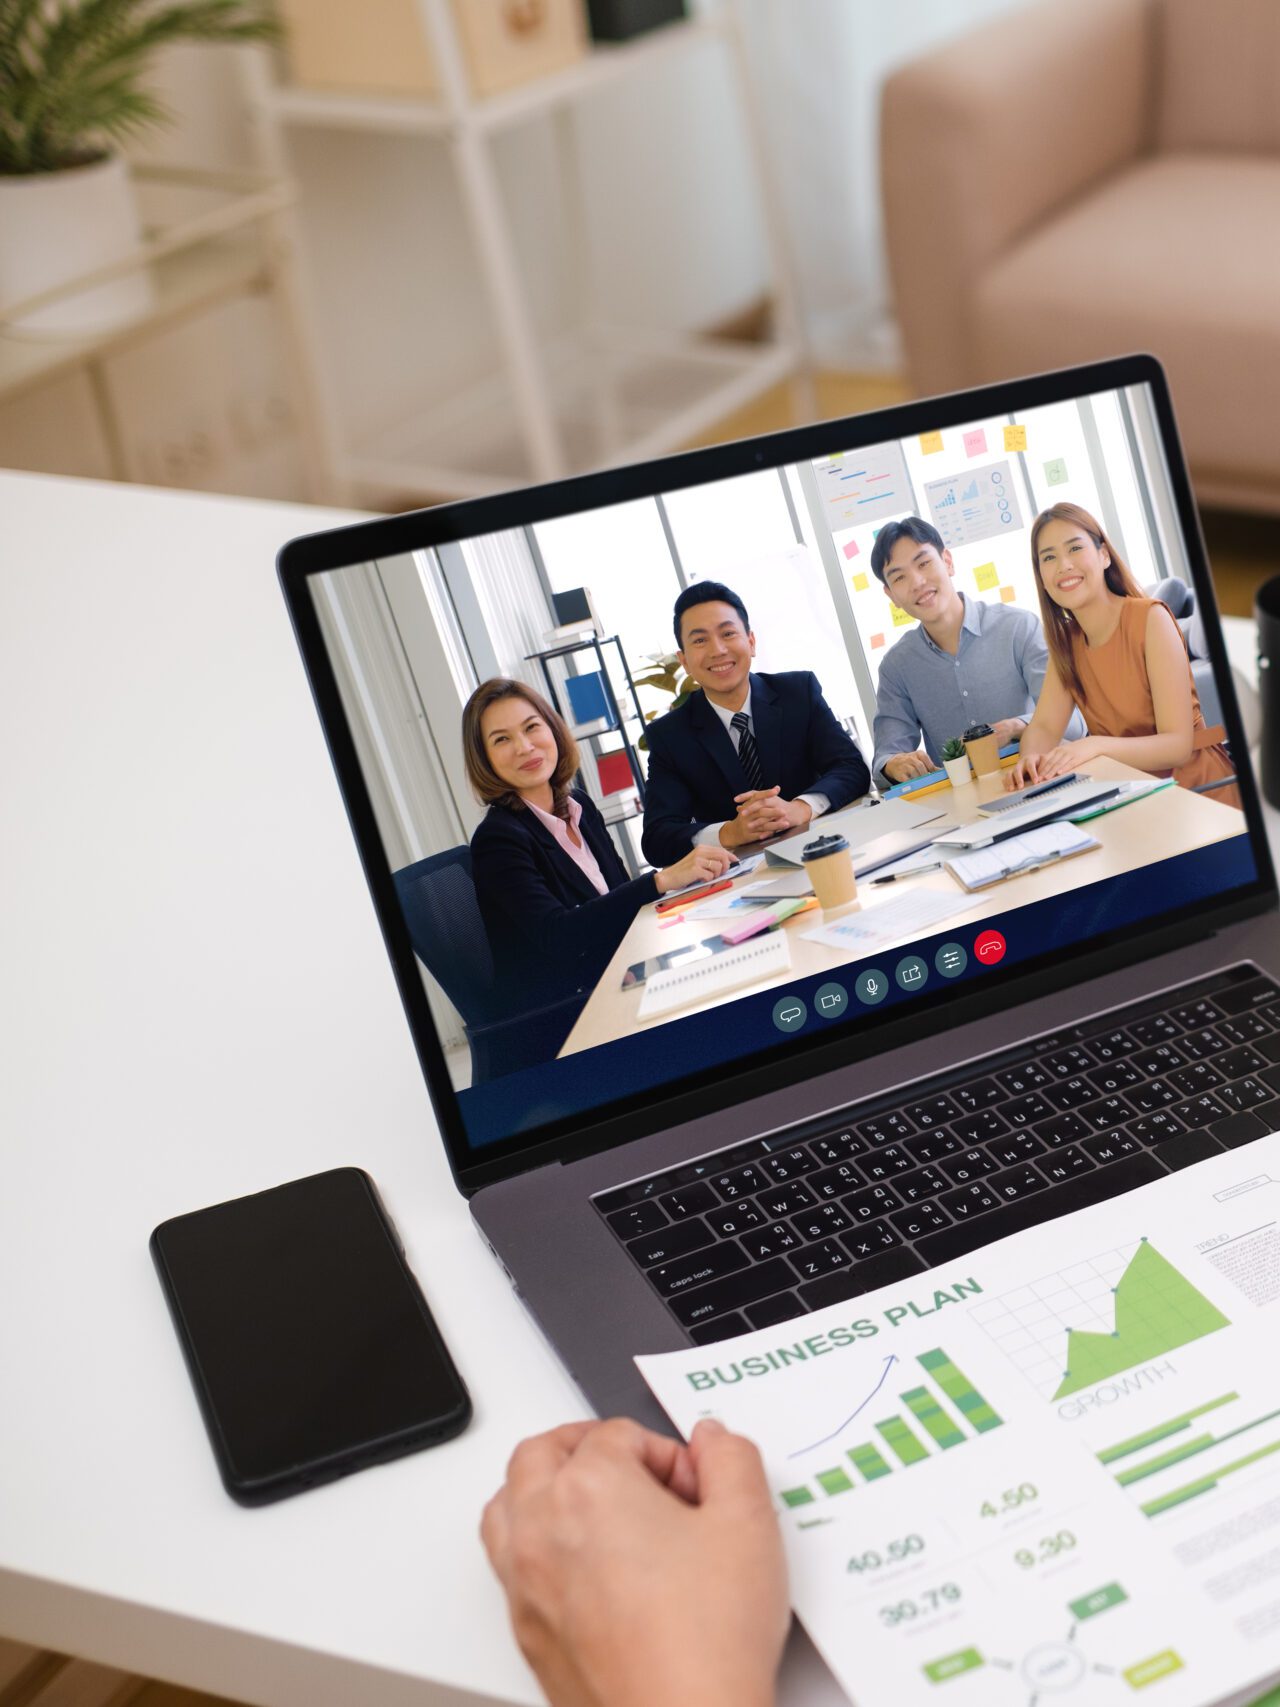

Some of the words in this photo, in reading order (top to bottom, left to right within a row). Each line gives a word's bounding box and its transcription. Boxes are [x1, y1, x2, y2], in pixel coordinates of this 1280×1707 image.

[1057, 1065, 1068, 1073] 9
[1105, 1080, 1117, 1088] O
[968, 1098, 976, 1106] 7
[1014, 1114, 1026, 1122] U
[1096, 1117, 1108, 1125] K
[874, 1133, 885, 1141] 5
[969, 1131, 978, 1139] Y
[1054, 1134, 1061, 1142] J
[828, 1150, 837, 1158] 4
[1004, 1152, 1017, 1160] H
[1099, 1149, 1113, 1158] M
[777, 1168, 787, 1176] 3
[873, 1167, 884, 1176] R
[957, 1170, 969, 1178] G
[1053, 1168, 1066, 1177] N
[727, 1186, 738, 1195] 2
[823, 1186, 834, 1194] E
[908, 1189, 917, 1197] F
[1005, 1187, 1017, 1195] B
[773, 1202, 787, 1212] W
[859, 1207, 870, 1216] D
[957, 1205, 967, 1213] V
[723, 1223, 735, 1231] Q
[809, 1226, 821, 1235] S
[909, 1224, 920, 1233] C
[1193, 1233, 1230, 1251] TREND
[760, 1246, 771, 1254] A
[858, 1243, 870, 1253] X
[648, 1250, 665, 1260] tab
[806, 1263, 818, 1273] Z
[669, 1275, 693, 1289] caps
[693, 1268, 714, 1280] lock
[691, 1304, 715, 1318] shift
[686, 1319, 879, 1391] BUSINESS
[883, 1277, 984, 1327] PLAN
[1057, 1360, 1177, 1421] GROWTH
[980, 1482, 1038, 1519] 4.50
[846, 1533, 926, 1575] 40.50
[1014, 1529, 1077, 1570] 9.30
[878, 1582, 962, 1628] 30.79
